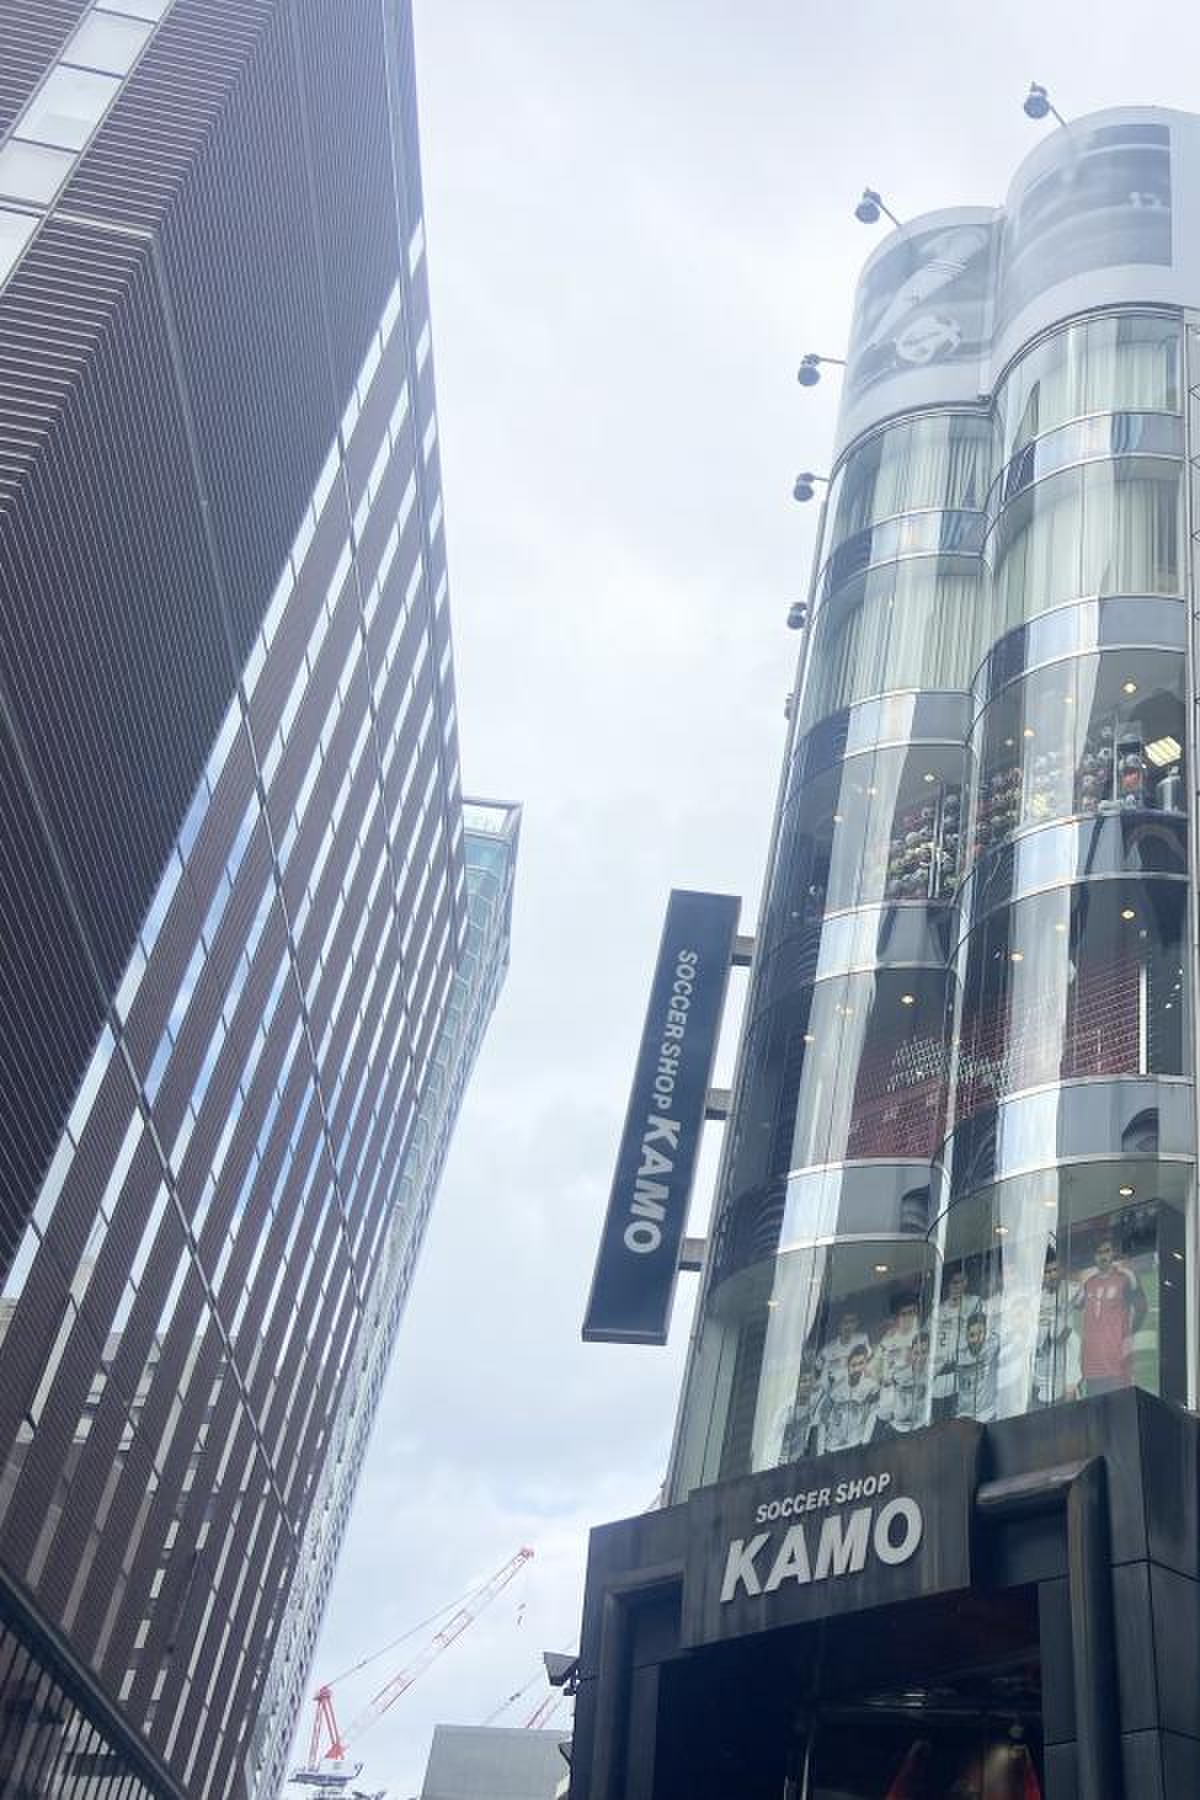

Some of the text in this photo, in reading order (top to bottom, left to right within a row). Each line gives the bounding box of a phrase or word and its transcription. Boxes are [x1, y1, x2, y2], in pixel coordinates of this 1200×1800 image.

[623, 949, 698, 1254] SOCCER SHOP KAMO
[719, 1497, 923, 1604] KAMO
[756, 1472, 891, 1523] SOCCER SHOP
